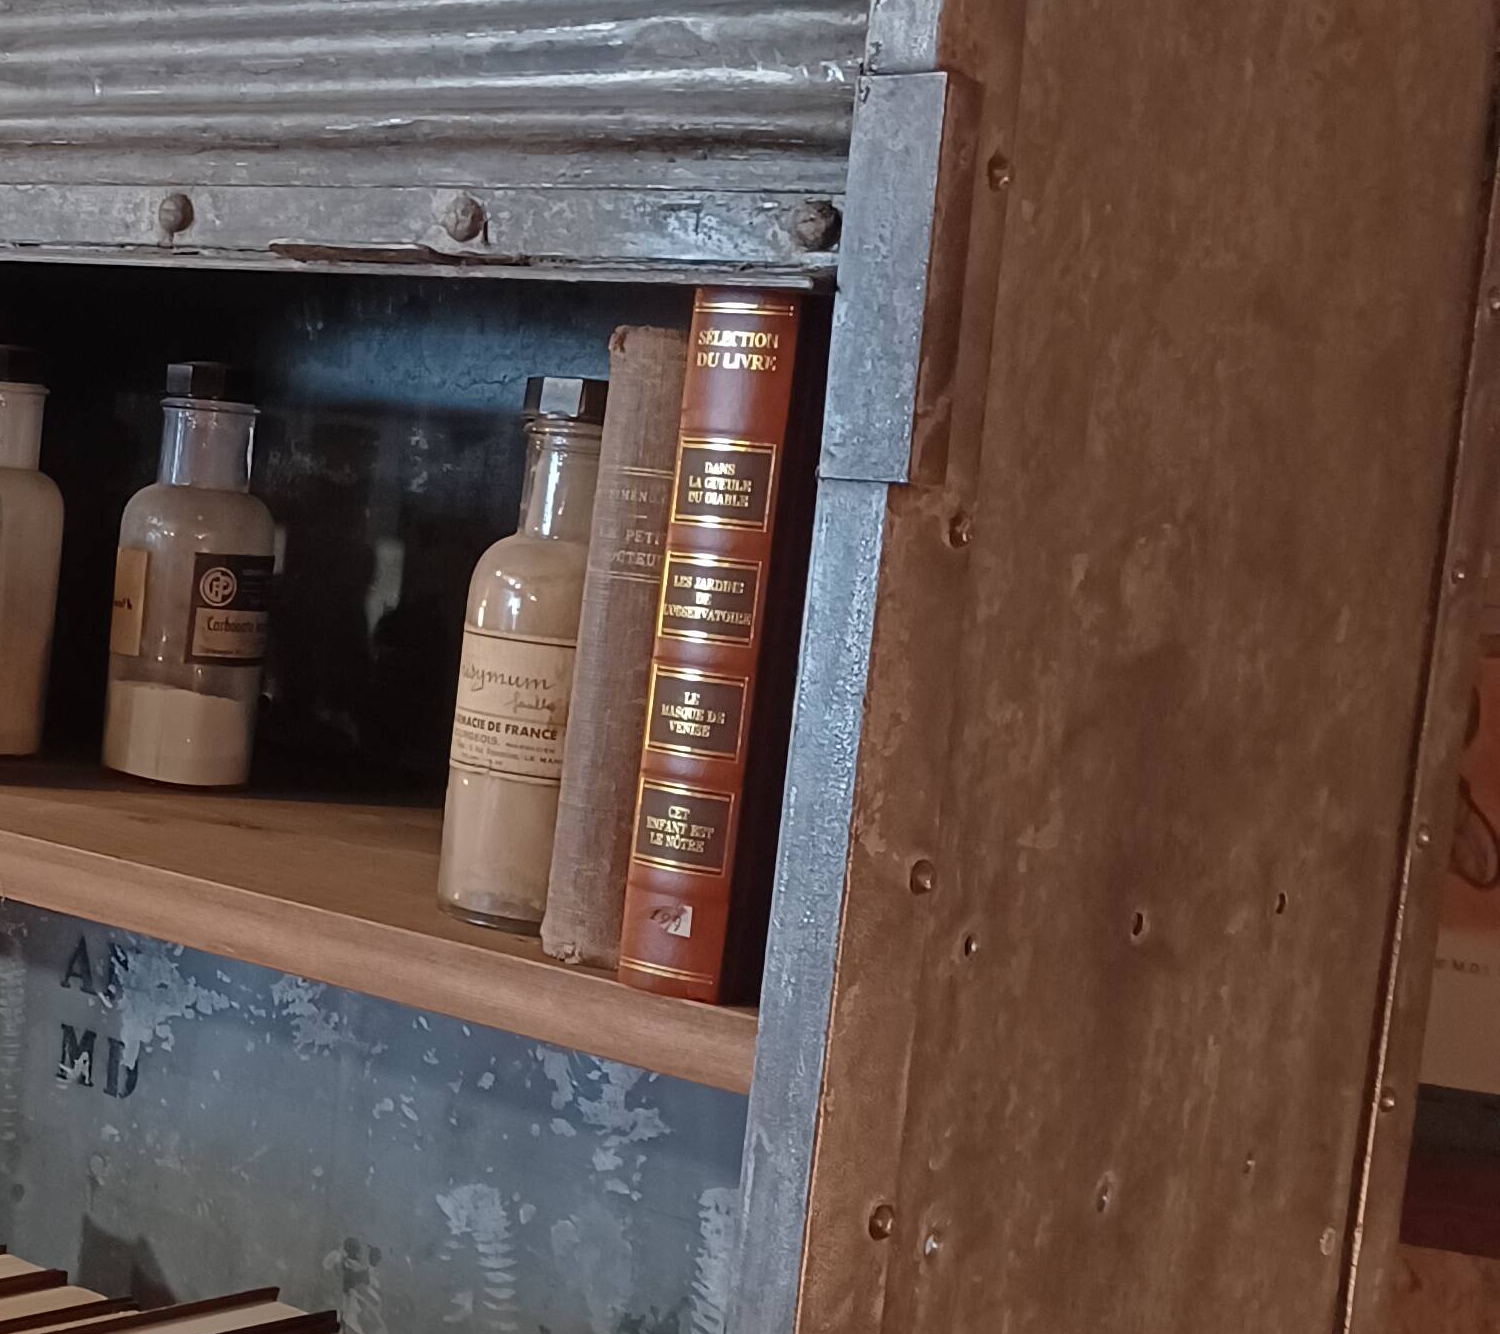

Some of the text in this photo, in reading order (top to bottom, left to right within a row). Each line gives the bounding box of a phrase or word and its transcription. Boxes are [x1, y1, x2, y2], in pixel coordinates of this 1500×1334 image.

[698, 328, 779, 349] SÉLECTION
[697, 352, 777, 371] DU LIVRE
[704, 461, 736, 476] DANS
[688, 475, 752, 493] LA GUEULE
[688, 491, 749, 508] DU DIABLE
[626, 529, 667, 546] PETI
[673, 575, 693, 588] LES
[695, 592, 713, 606] DE
[684, 691, 700, 706] LE
[661, 703, 726, 725] MASQUE DE
[487, 721, 501, 733] DE
[505, 724, 558, 741] FRANCE
[669, 720, 711, 738] VENISE
[540, 756, 563, 765] MAN
[668, 805, 691, 820] CET
[646, 816, 715, 840] ENFANT EST
[650, 831, 704, 854] LE NÔTRE
